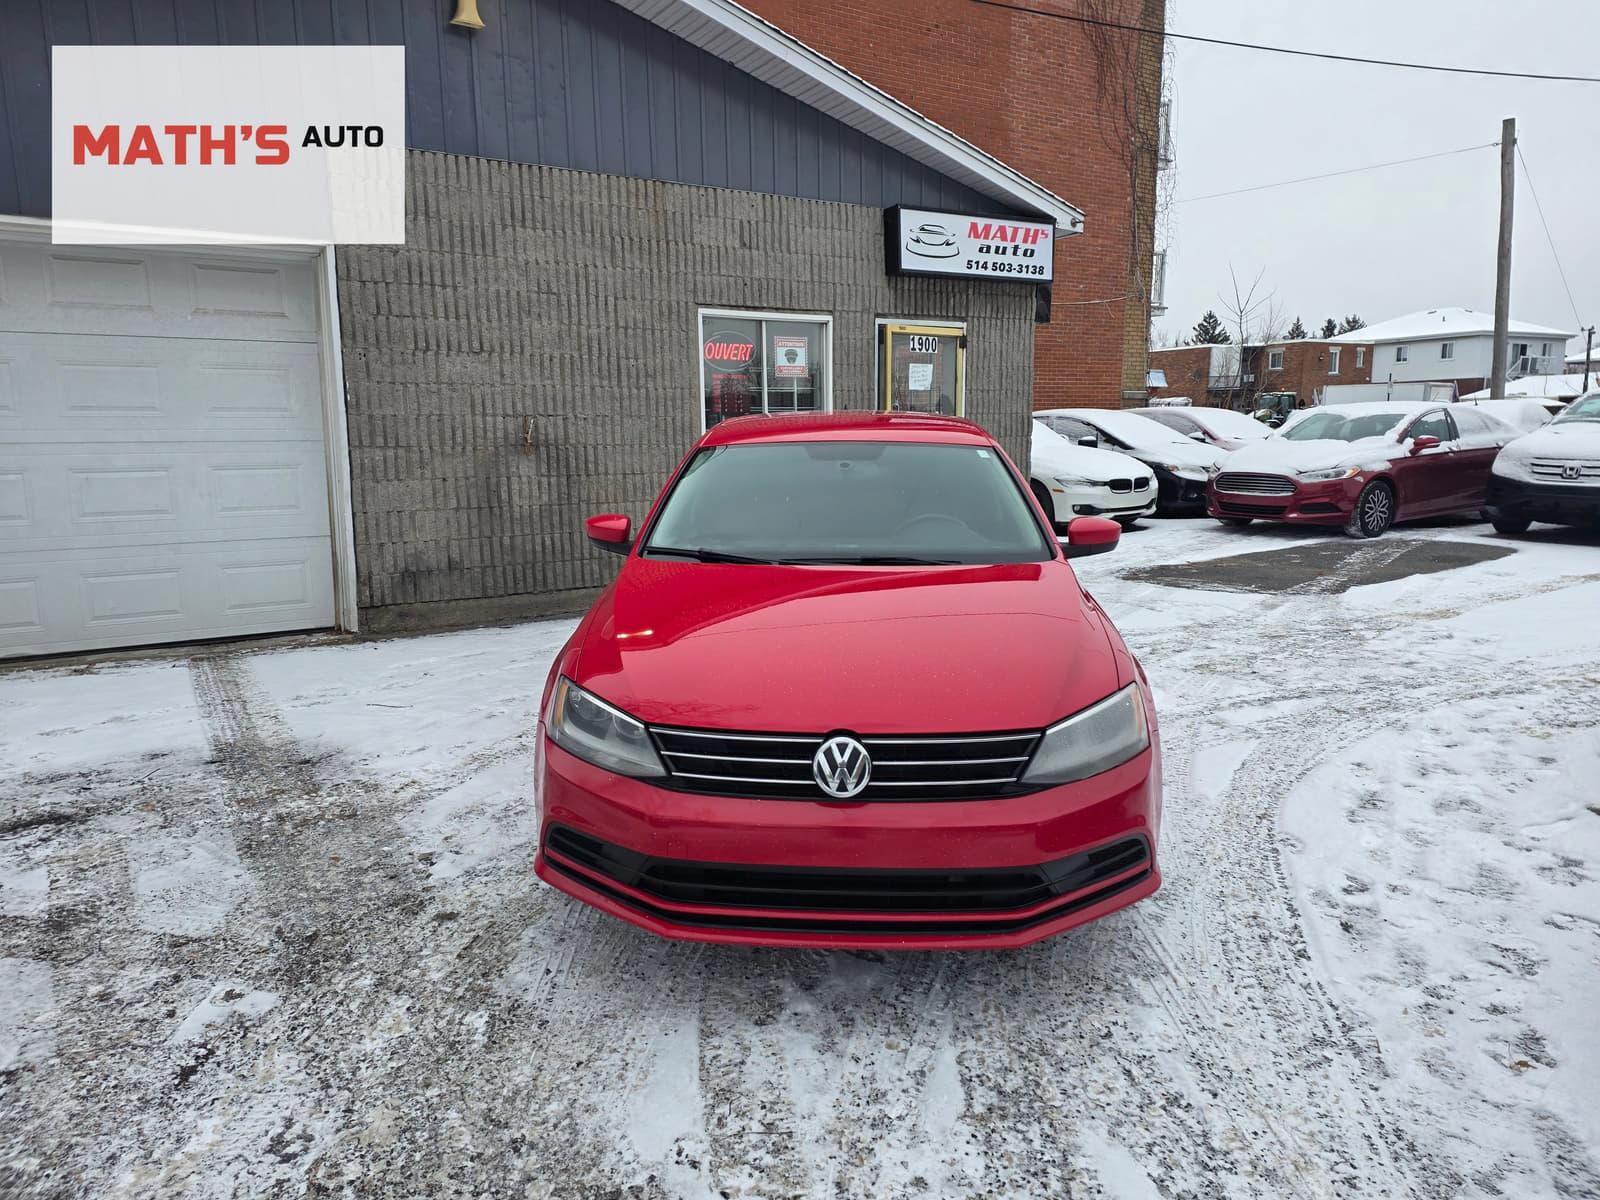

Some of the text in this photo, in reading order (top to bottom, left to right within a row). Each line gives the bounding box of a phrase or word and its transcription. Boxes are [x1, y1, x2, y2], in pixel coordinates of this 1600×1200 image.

[978, 243, 1036, 258] auto
[966, 260, 1045, 275] 514 503-3138
[704, 342, 753, 361] OUVERT
[910, 336, 937, 352] 1900
